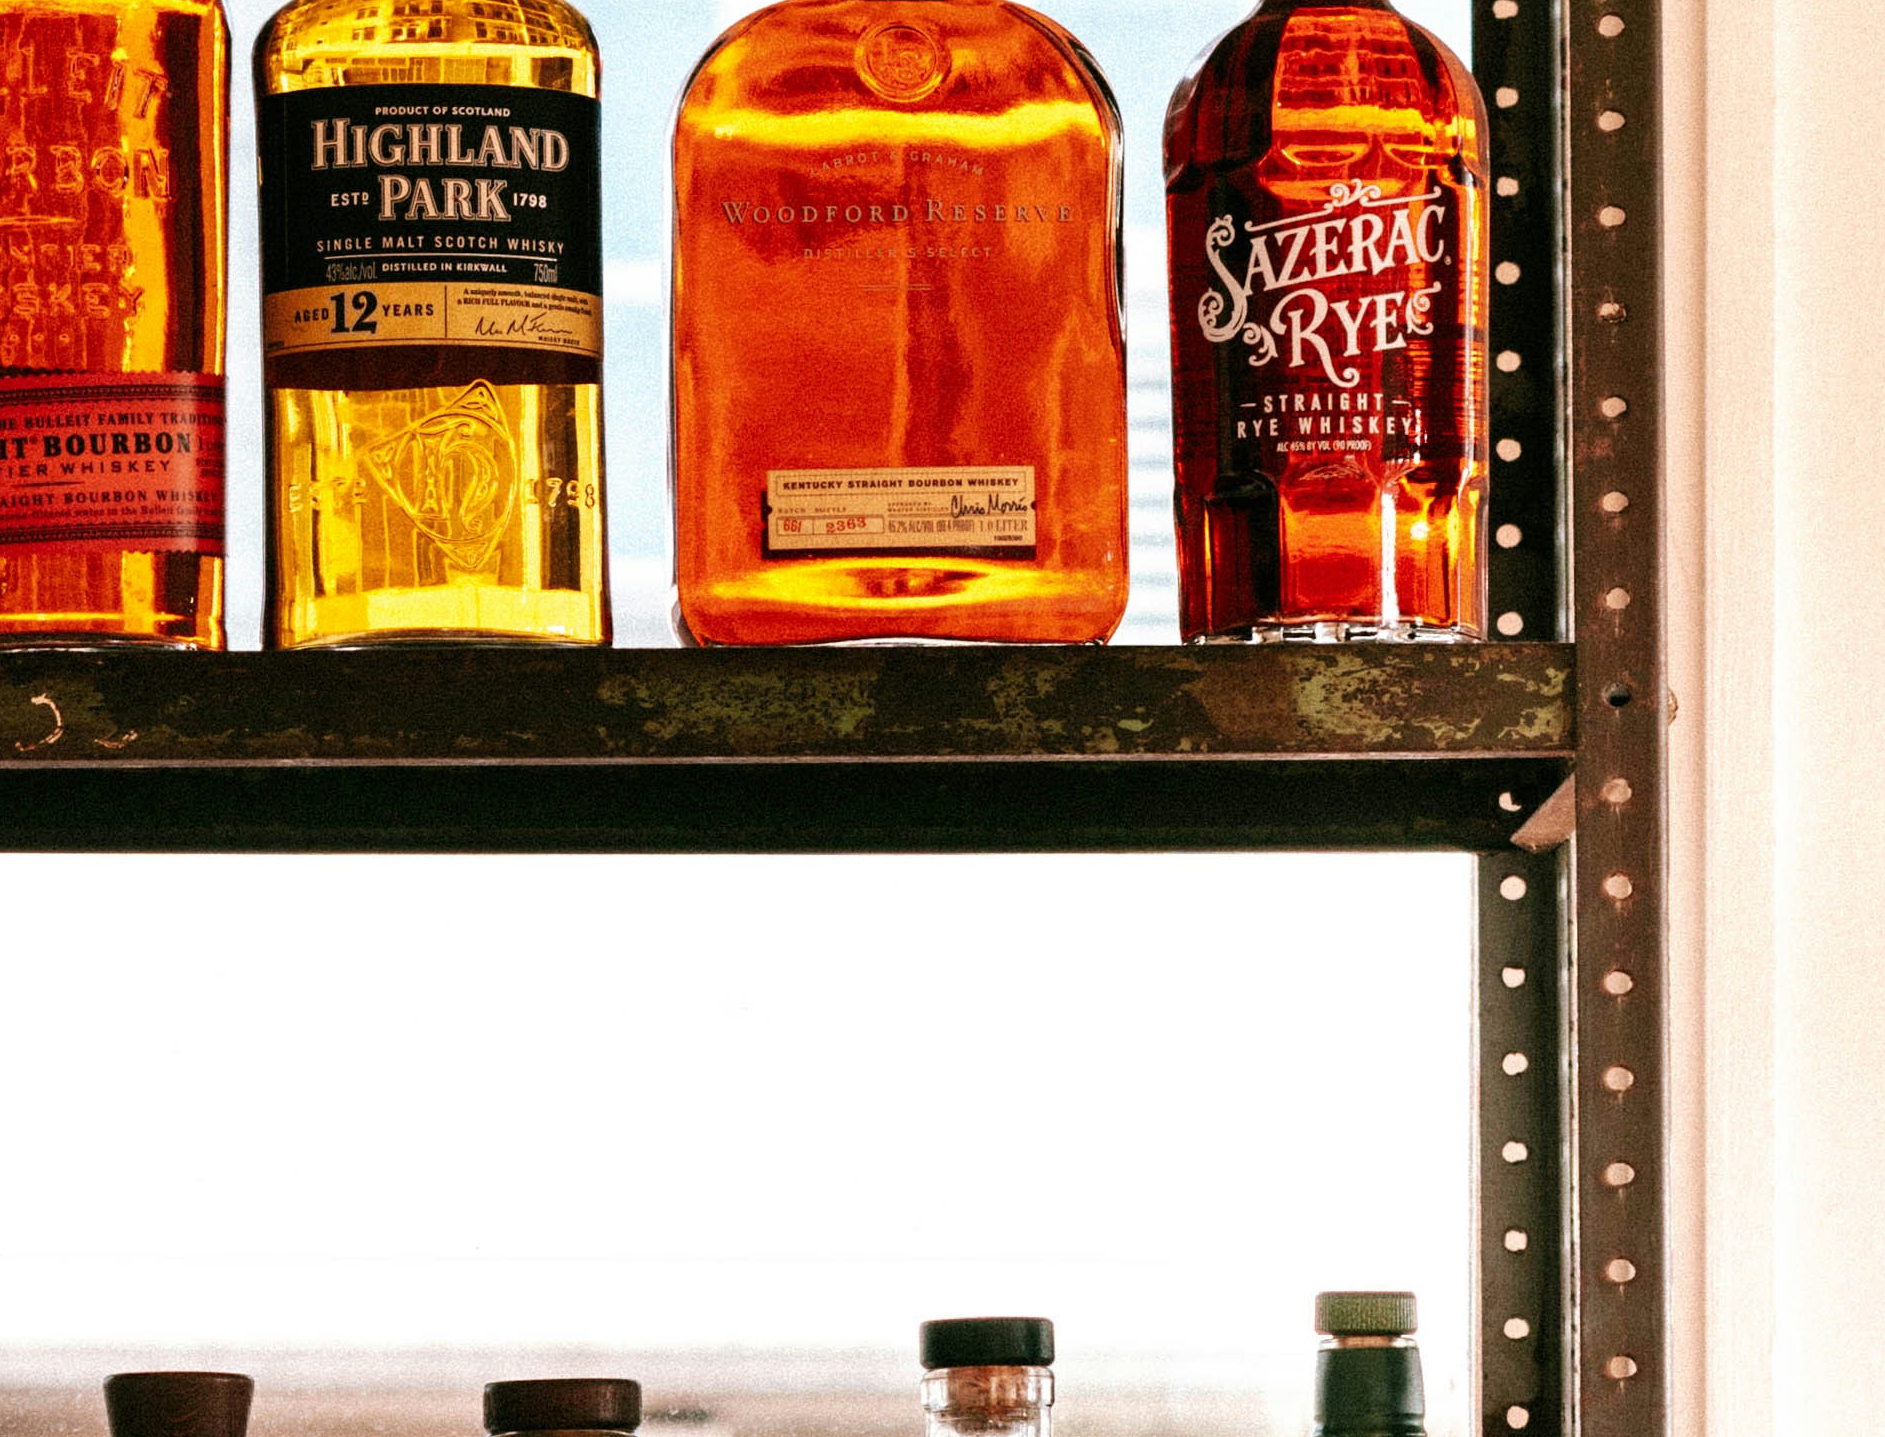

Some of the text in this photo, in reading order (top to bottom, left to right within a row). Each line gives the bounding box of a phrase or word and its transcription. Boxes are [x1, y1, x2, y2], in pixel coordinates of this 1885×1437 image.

[375, 106, 511, 118] PRODUCT OF SCOTLAND
[310, 117, 570, 172] HIGHLAND
[378, 174, 512, 223] PARK
[513, 192, 548, 209] 1798
[722, 199, 1077, 226] WOODFORD RESERVE
[317, 236, 565, 255] SINGLE MALT SCOTCH WHISKY
[1198, 205, 1446, 342] SAZERAC
[294, 290, 434, 335] AGED 12 YEARS
[1270, 288, 1408, 388] RYE
[1264, 393, 1384, 414] STRAIGHT
[24, 414, 92, 430] BULLEIT
[98, 412, 154, 428] FAMILY
[1237, 416, 1412, 439] RYE WHISKEY
[43, 432, 193, 460] BOURBON
[61, 459, 172, 477] WHISKEY
[782, 477, 1020, 492] KENTUCKY STRAIGHT BOURBON WHISKEY
[63, 490, 148, 505] BOURBON
